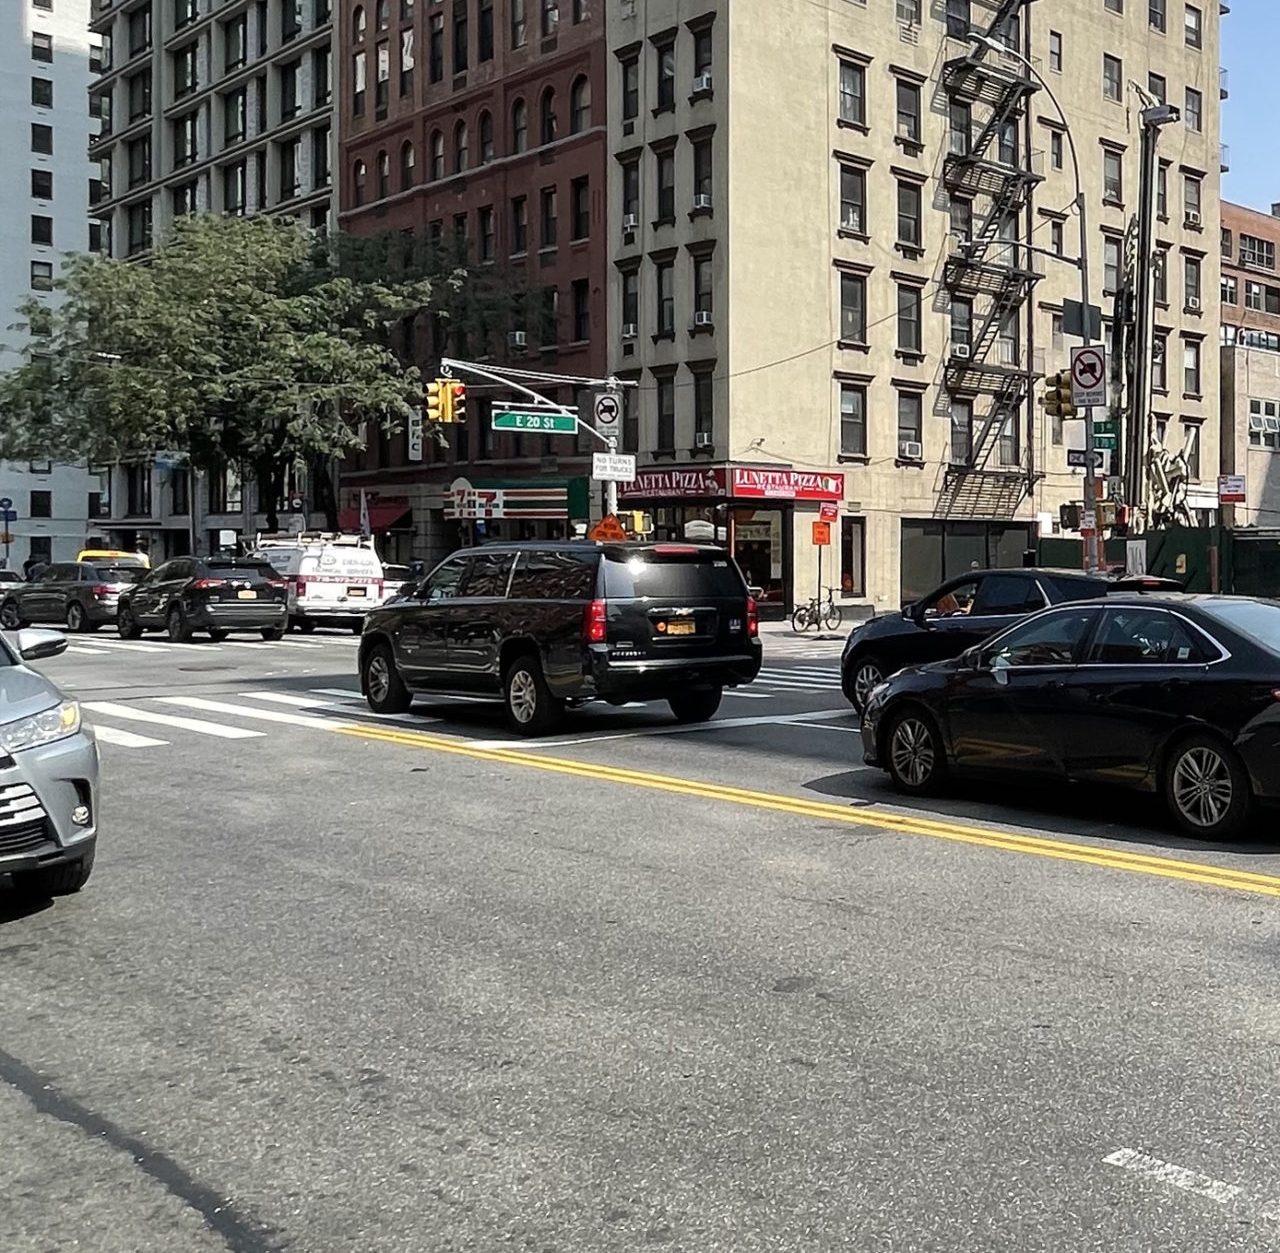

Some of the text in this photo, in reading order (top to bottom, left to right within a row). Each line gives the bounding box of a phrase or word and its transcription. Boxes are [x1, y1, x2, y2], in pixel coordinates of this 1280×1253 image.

[516, 416, 555, 428] E 20 St
[608, 457, 632, 465] TURNS
[595, 465, 633, 474] FOR TRUCKS
[672, 471, 705, 489] PIZZA
[735, 468, 823, 489] LUNETTA PIZZA
